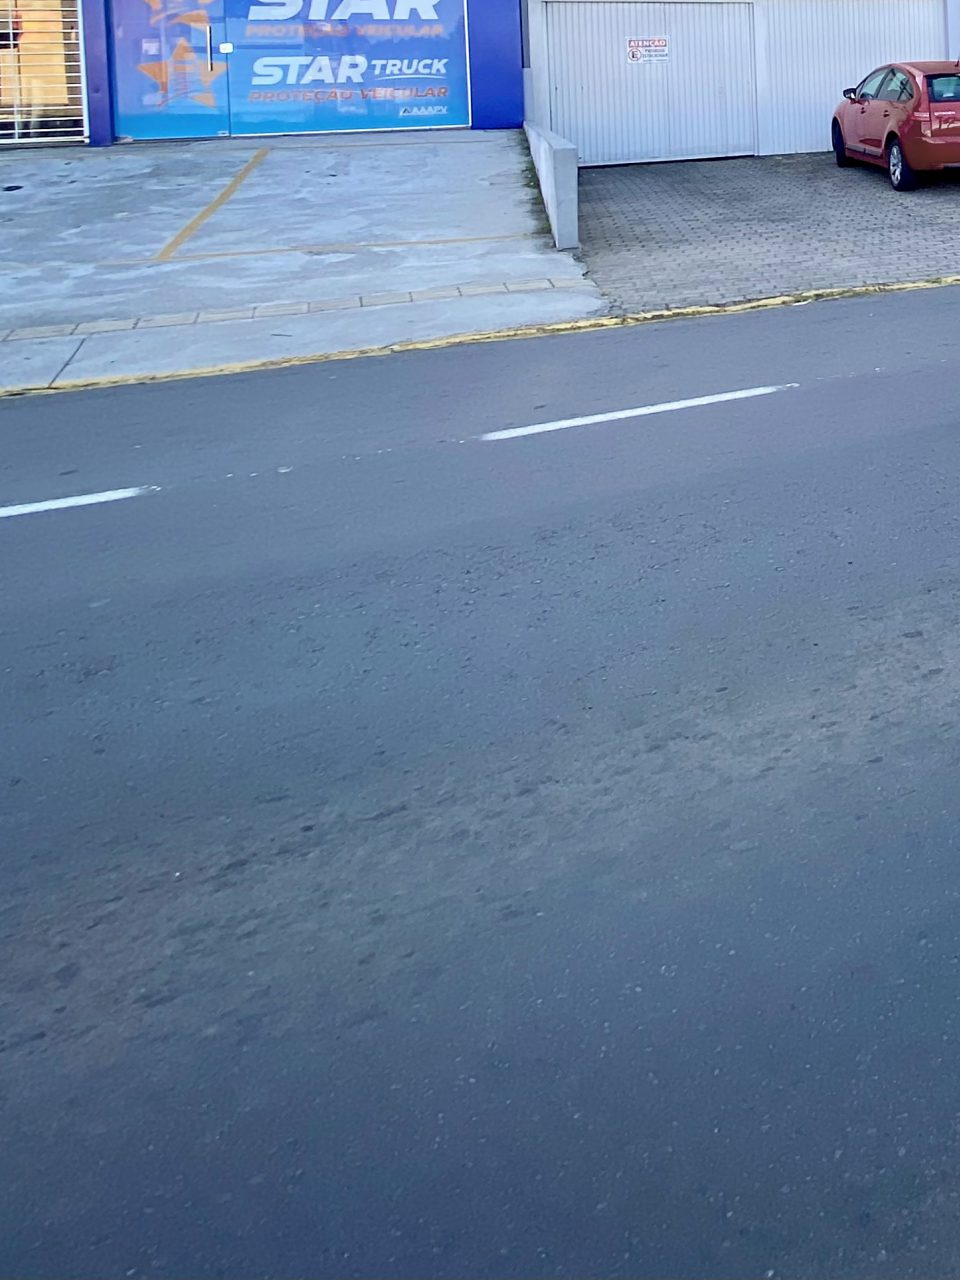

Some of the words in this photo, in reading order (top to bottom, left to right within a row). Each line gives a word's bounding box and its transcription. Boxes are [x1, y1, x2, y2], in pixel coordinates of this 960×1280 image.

[251, 55, 369, 86] STAR
[371, 58, 449, 76] TRUCK
[249, 87, 353, 104] PROTEÇÃO
[360, 86, 449, 100] VEICULAR
